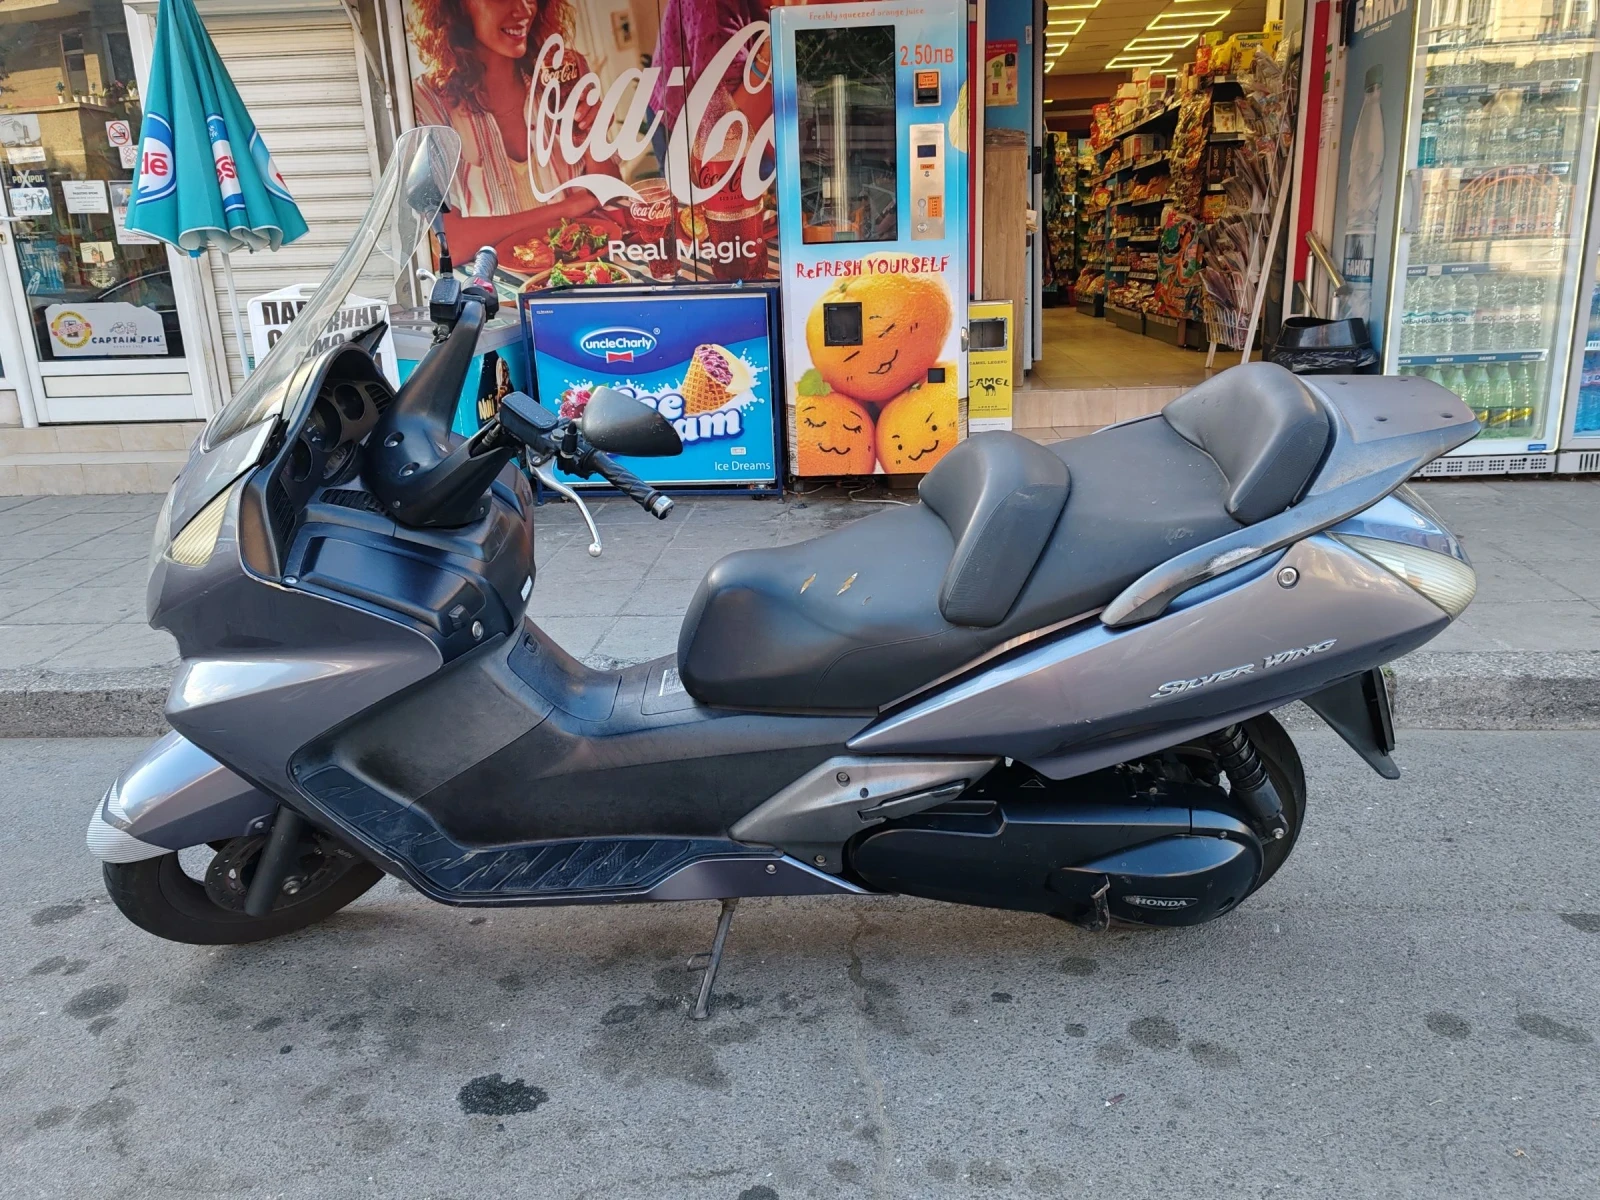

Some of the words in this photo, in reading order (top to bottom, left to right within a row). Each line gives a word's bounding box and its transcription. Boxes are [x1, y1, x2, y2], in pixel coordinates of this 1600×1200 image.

[809, 11, 838, 21] Freshly
[839, 9, 876, 20] squeezed
[878, 8, 904, 18] orange
[906, 7, 925, 16] juice
[12, 169, 45, 189] POXIPOL
[608, 237, 668, 262] Real
[676, 235, 757, 264] Magic
[866, 254, 950, 275] YOURSELF
[91, 336, 137, 344] CAPTAIN
[140, 335, 160, 343] PEN
[585, 337, 653, 350] uncleCharly
[714, 461, 729, 471] Ice
[731, 460, 771, 471] Dreams
[1150, 663, 1255, 698] SILVER
[1262, 638, 1338, 669] WING
[1136, 897, 1188, 907] HONDA
